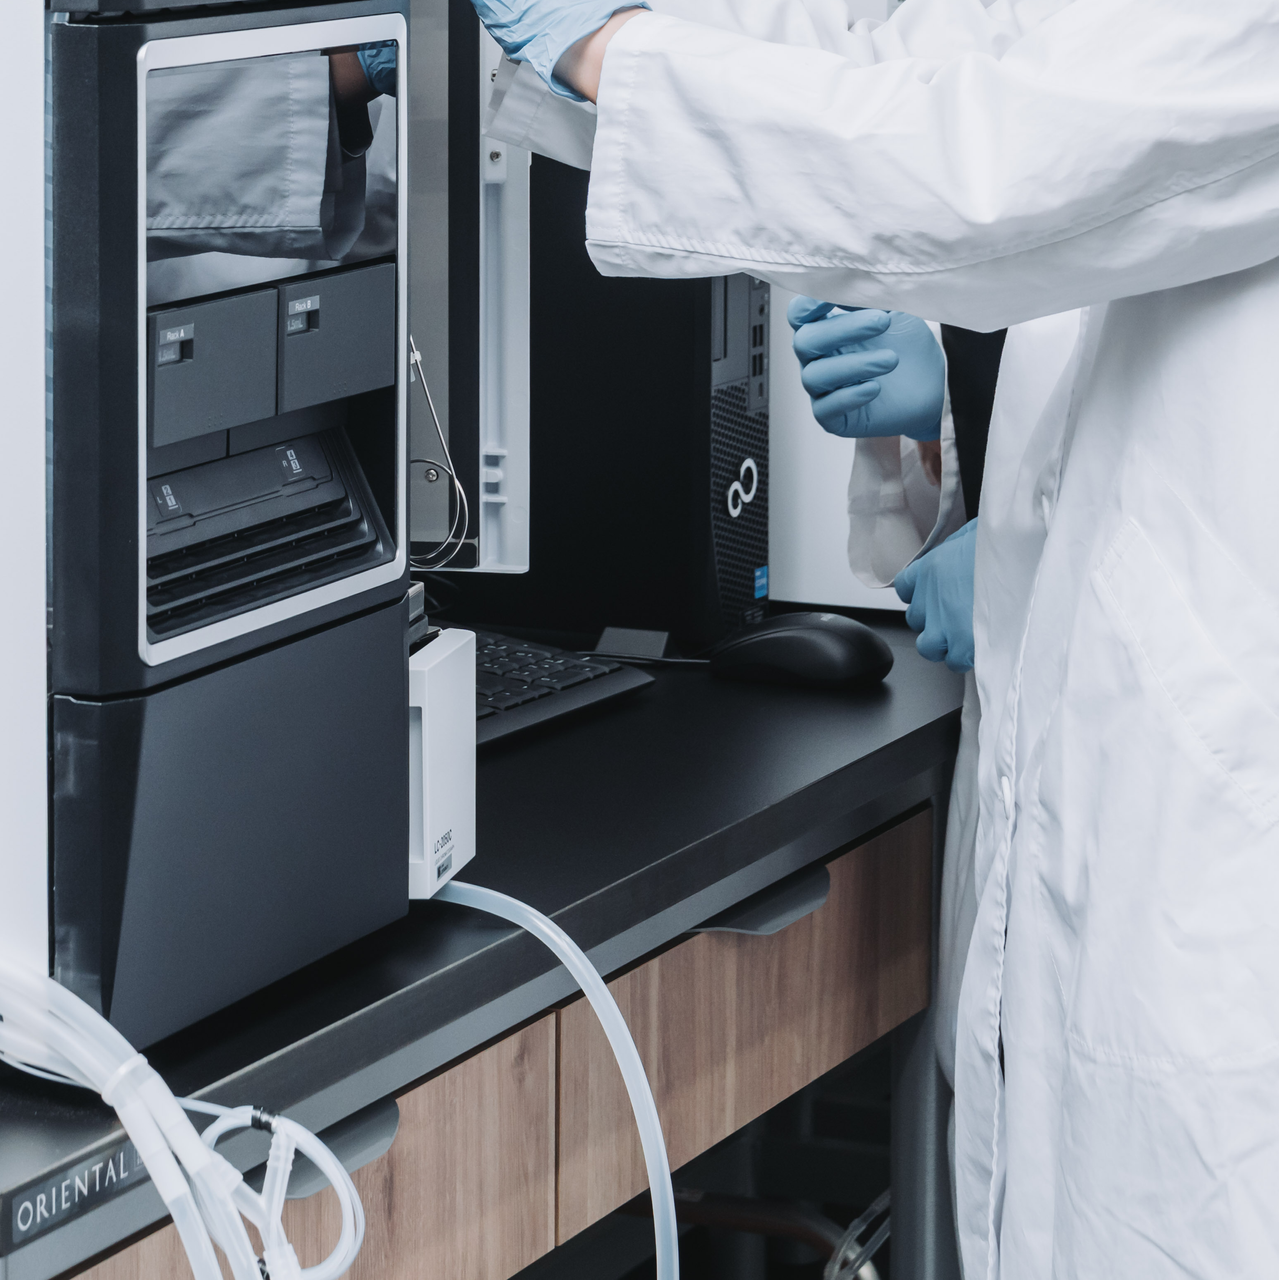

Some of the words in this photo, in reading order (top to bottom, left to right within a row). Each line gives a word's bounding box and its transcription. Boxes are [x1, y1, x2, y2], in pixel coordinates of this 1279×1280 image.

[294, 302, 307, 312] Rack
[306, 300, 312, 309] B
[166, 330, 180, 341] Rack
[179, 328, 185, 338] A
[282, 460, 289, 468] R
[156, 496, 163, 504] L
[17, 1151, 129, 1232] ORIENTAL
